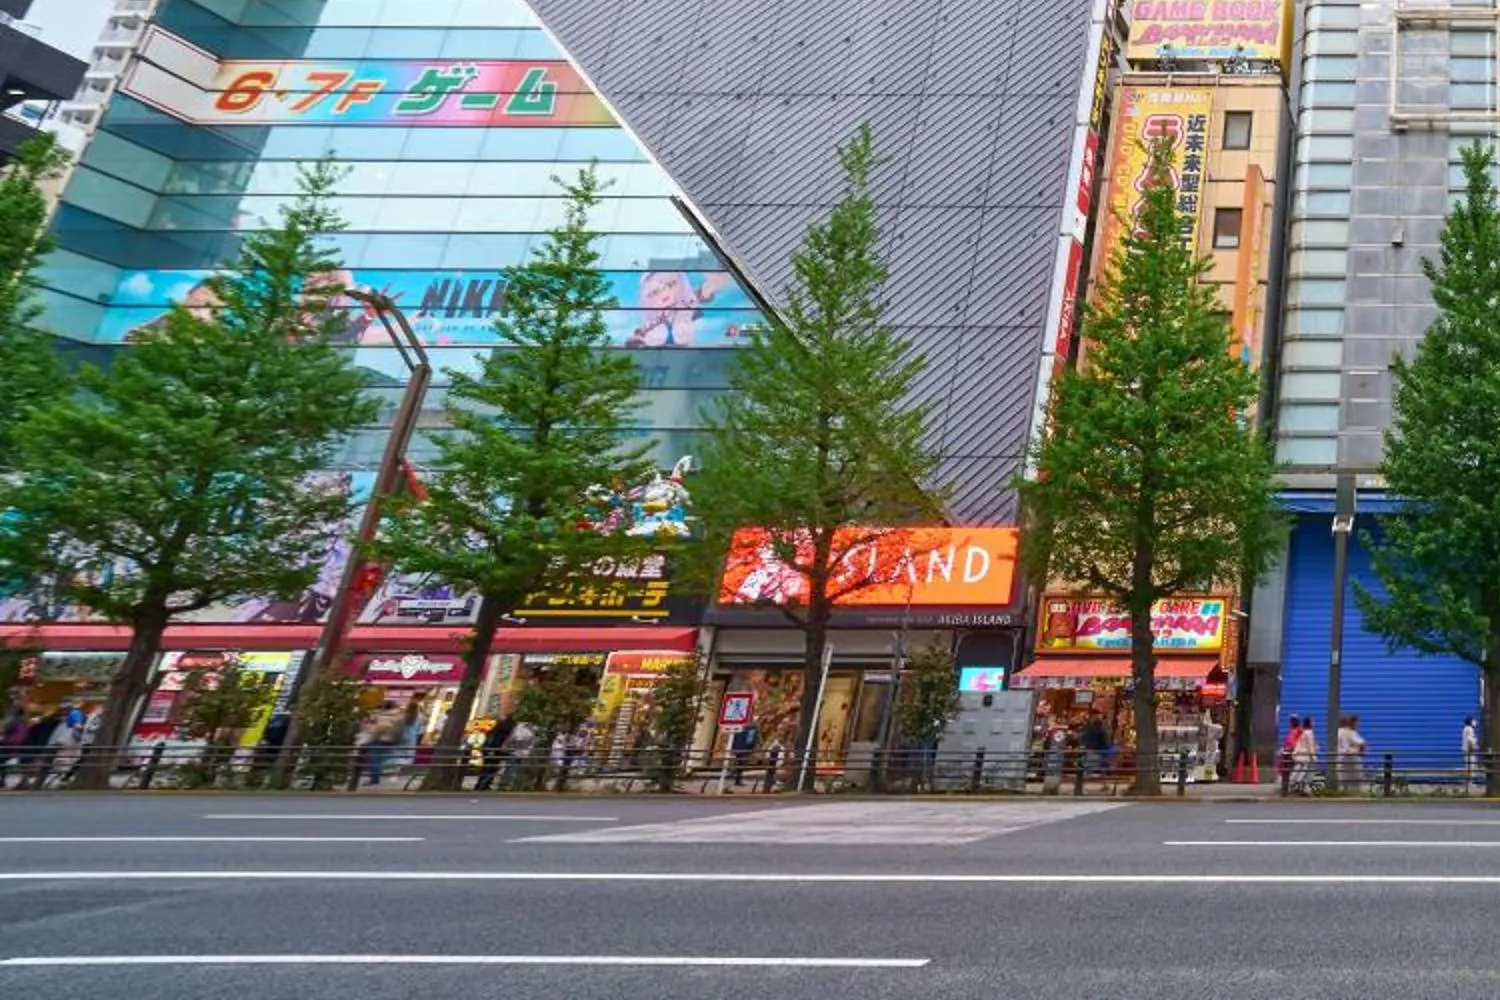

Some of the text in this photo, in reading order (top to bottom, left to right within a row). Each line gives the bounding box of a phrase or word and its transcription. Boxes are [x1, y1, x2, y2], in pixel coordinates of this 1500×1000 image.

[392, 63, 559, 116] ゲーム
[972, 615, 1011, 625] ISLAND
